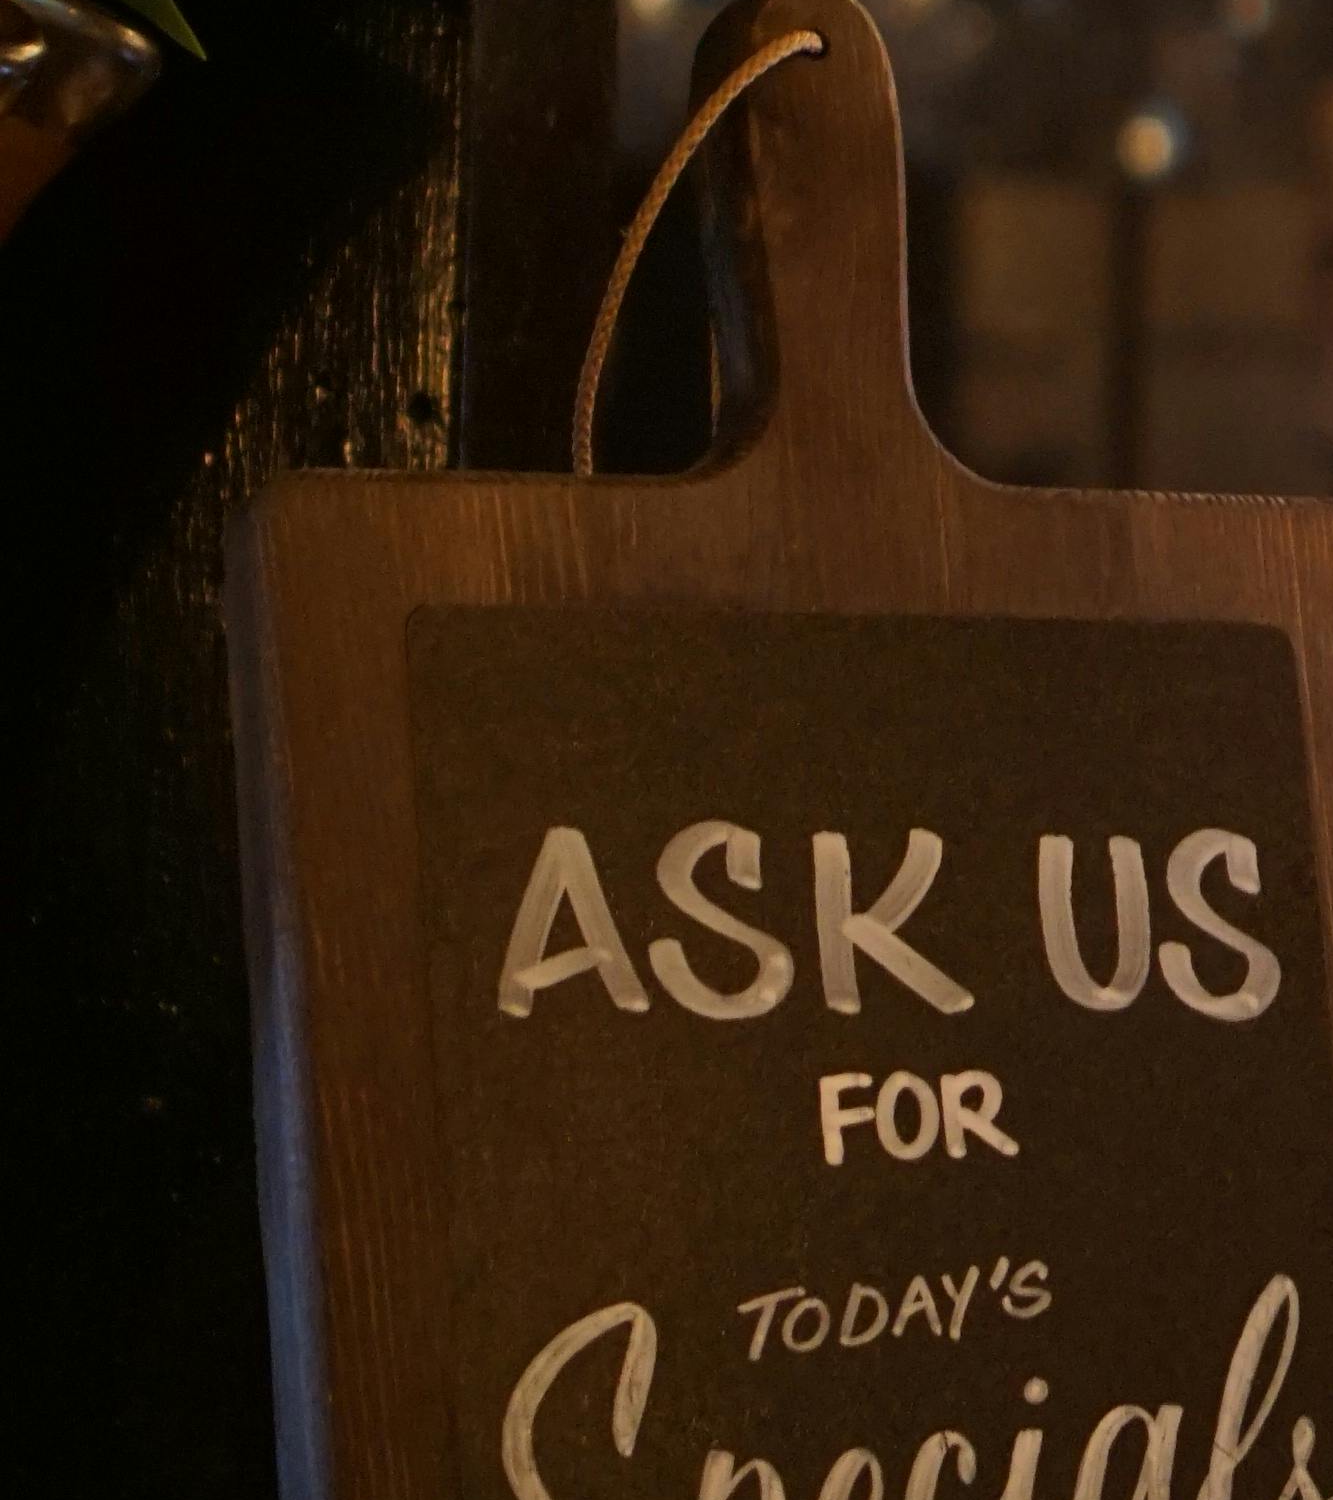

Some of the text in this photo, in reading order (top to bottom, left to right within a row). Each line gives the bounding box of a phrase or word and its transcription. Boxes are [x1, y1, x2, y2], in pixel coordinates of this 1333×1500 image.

[497, 819, 1283, 1022] ASK US
[818, 1069, 1020, 1166] FOR
[736, 1257, 1053, 1362] TODAY'S
